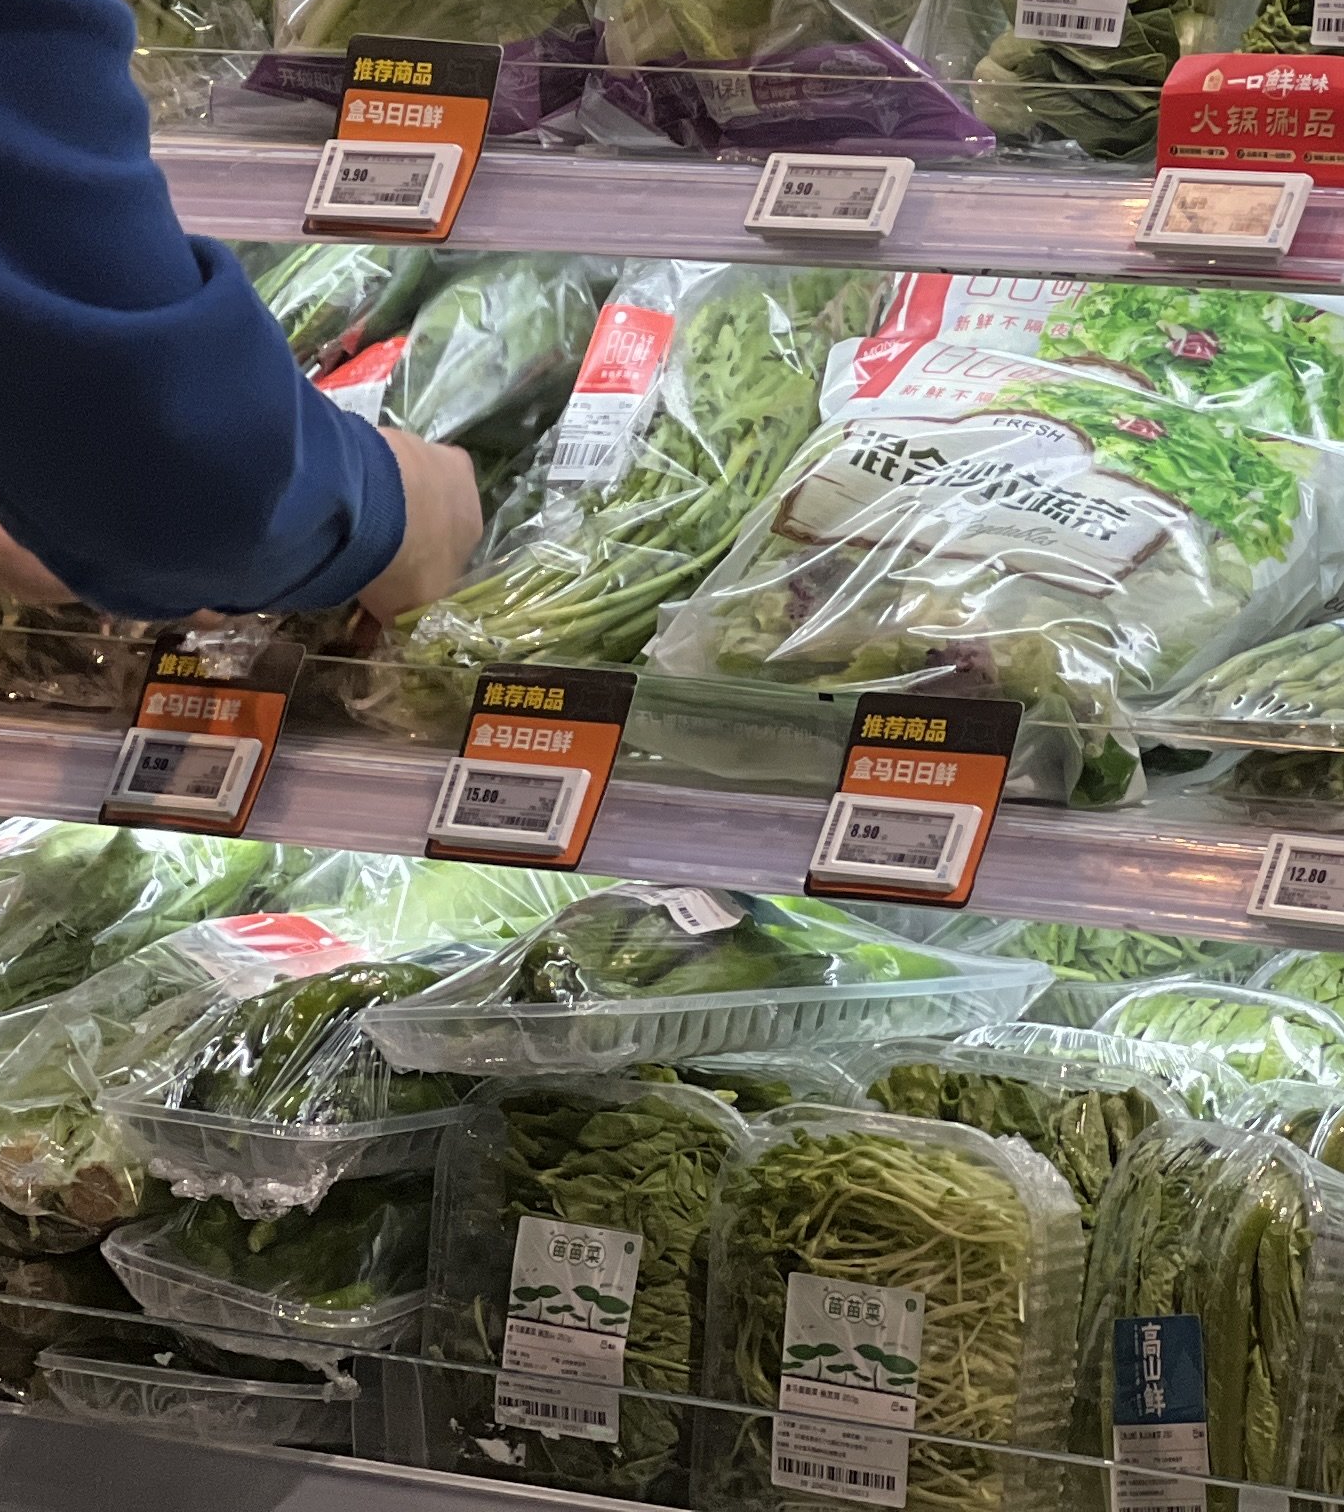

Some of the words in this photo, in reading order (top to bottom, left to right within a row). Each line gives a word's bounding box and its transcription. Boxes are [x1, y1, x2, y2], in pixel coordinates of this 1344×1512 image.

[353, 57, 433, 85] 推荐商品
[345, 98, 444, 128] 盒马日日鲜
[1189, 102, 1337, 140] 火锅涮品
[953, 312, 1070, 337] 新鲜不隔夜
[992, 415, 1065, 442] FRESH
[145, 692, 242, 720] 盒马日日鲜
[483, 682, 565, 711] 推荐商品
[472, 723, 574, 753] 盒马日日鲜
[861, 714, 947, 743] 推荐商品
[849, 756, 958, 787] 盒马日日鲜
[552, 1238, 603, 1264] 苗苗菜
[827, 1294, 882, 1324] 苗苗菜
[1140, 1322, 1167, 1419] 高山鲜
